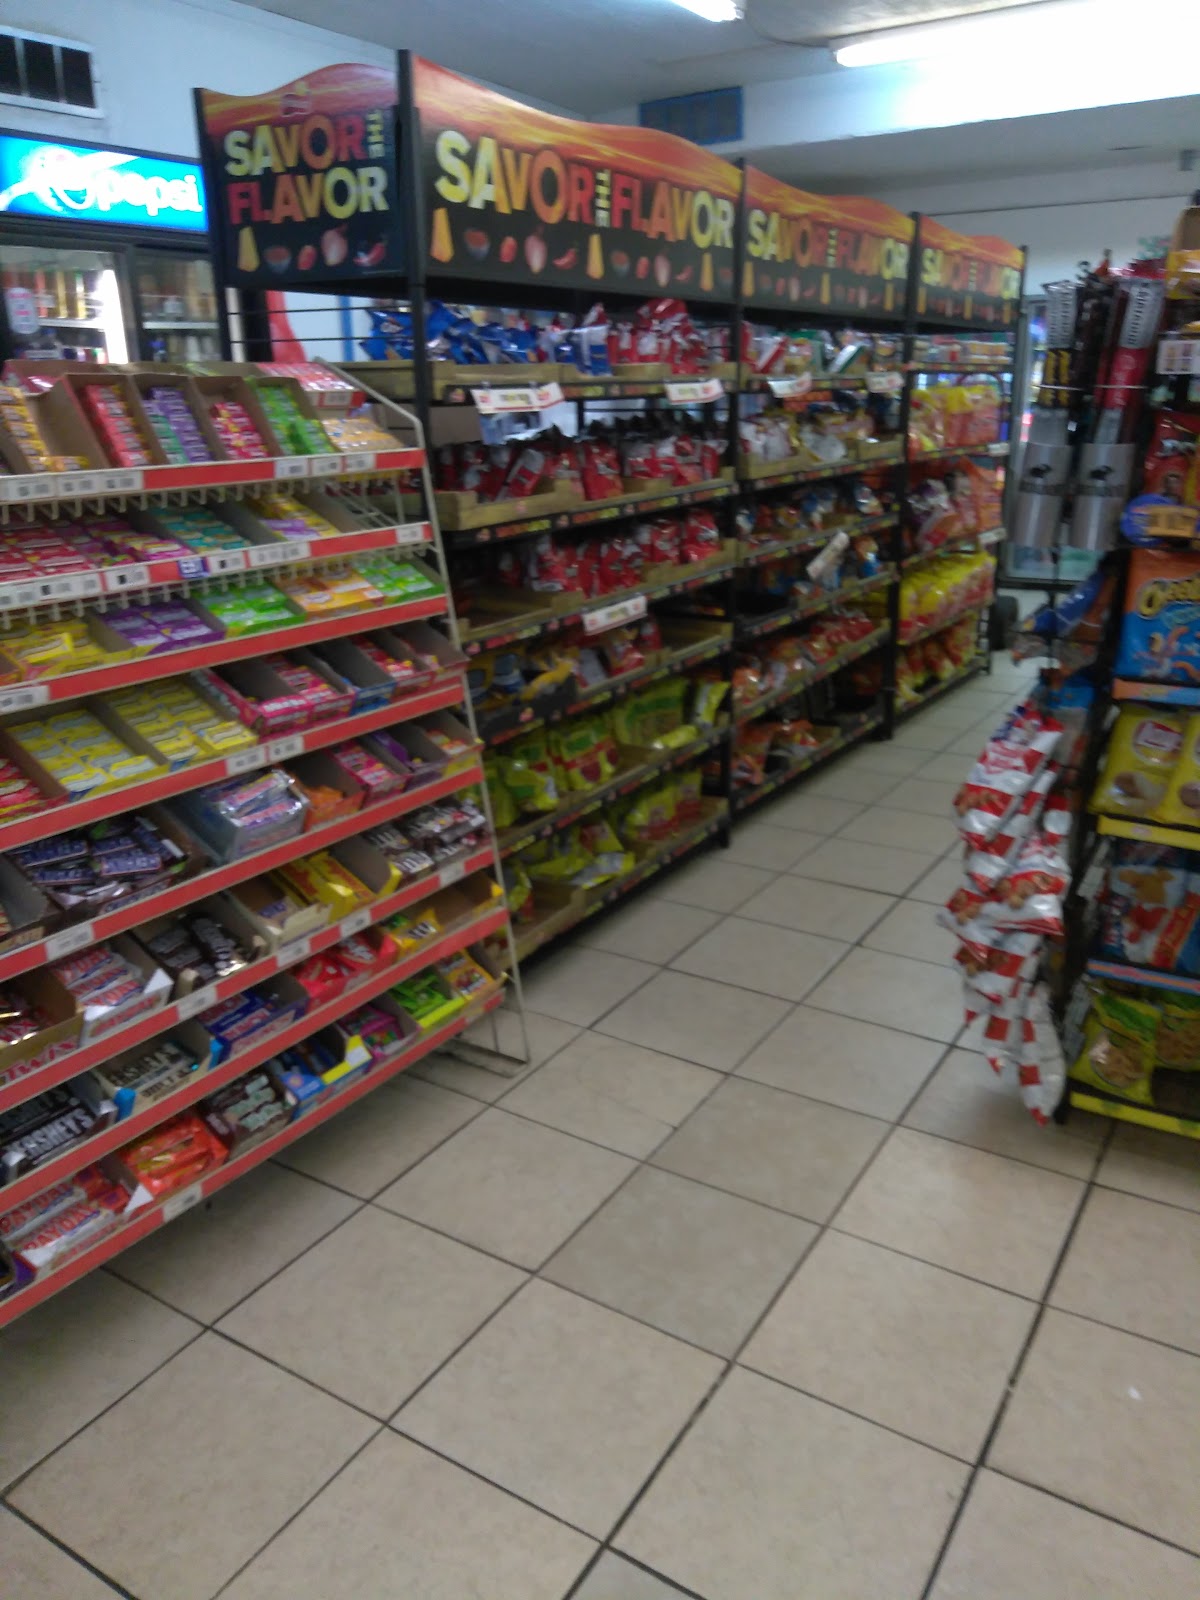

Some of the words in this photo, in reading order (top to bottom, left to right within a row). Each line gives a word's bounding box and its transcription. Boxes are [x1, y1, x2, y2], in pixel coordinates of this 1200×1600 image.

[224, 114, 368, 176] SAVOR
[365, 109, 385, 159] THE
[96, 170, 203, 216] pepsi
[227, 166, 389, 225] FLAVOR
[434, 130, 594, 224] SAVOR
[594, 168, 612, 228] THE
[610, 171, 736, 249] FLAVOR
